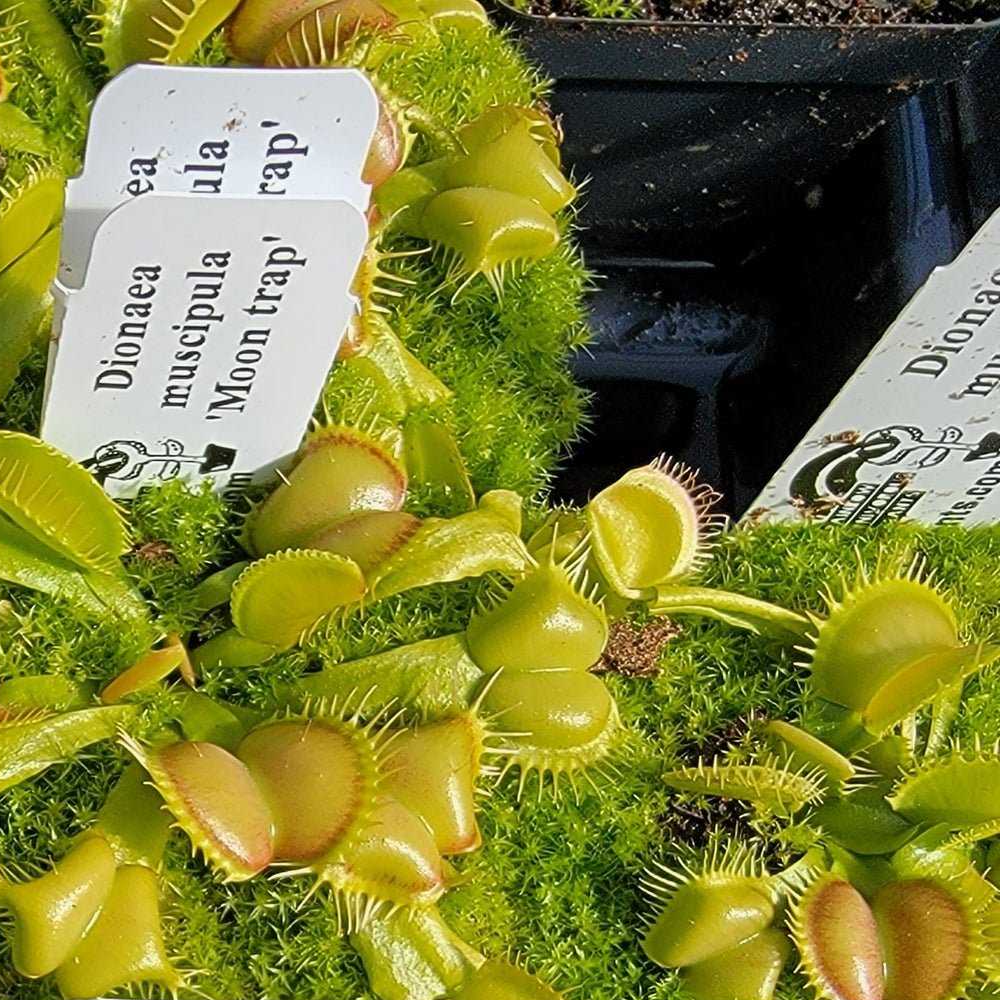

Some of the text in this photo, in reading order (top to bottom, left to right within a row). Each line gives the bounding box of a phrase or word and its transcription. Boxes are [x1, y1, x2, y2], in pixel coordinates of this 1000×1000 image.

[94, 265, 162, 391] Dionaea
[161, 251, 231, 409] muscipula
[205, 236, 307, 420] 'Moon trap'
